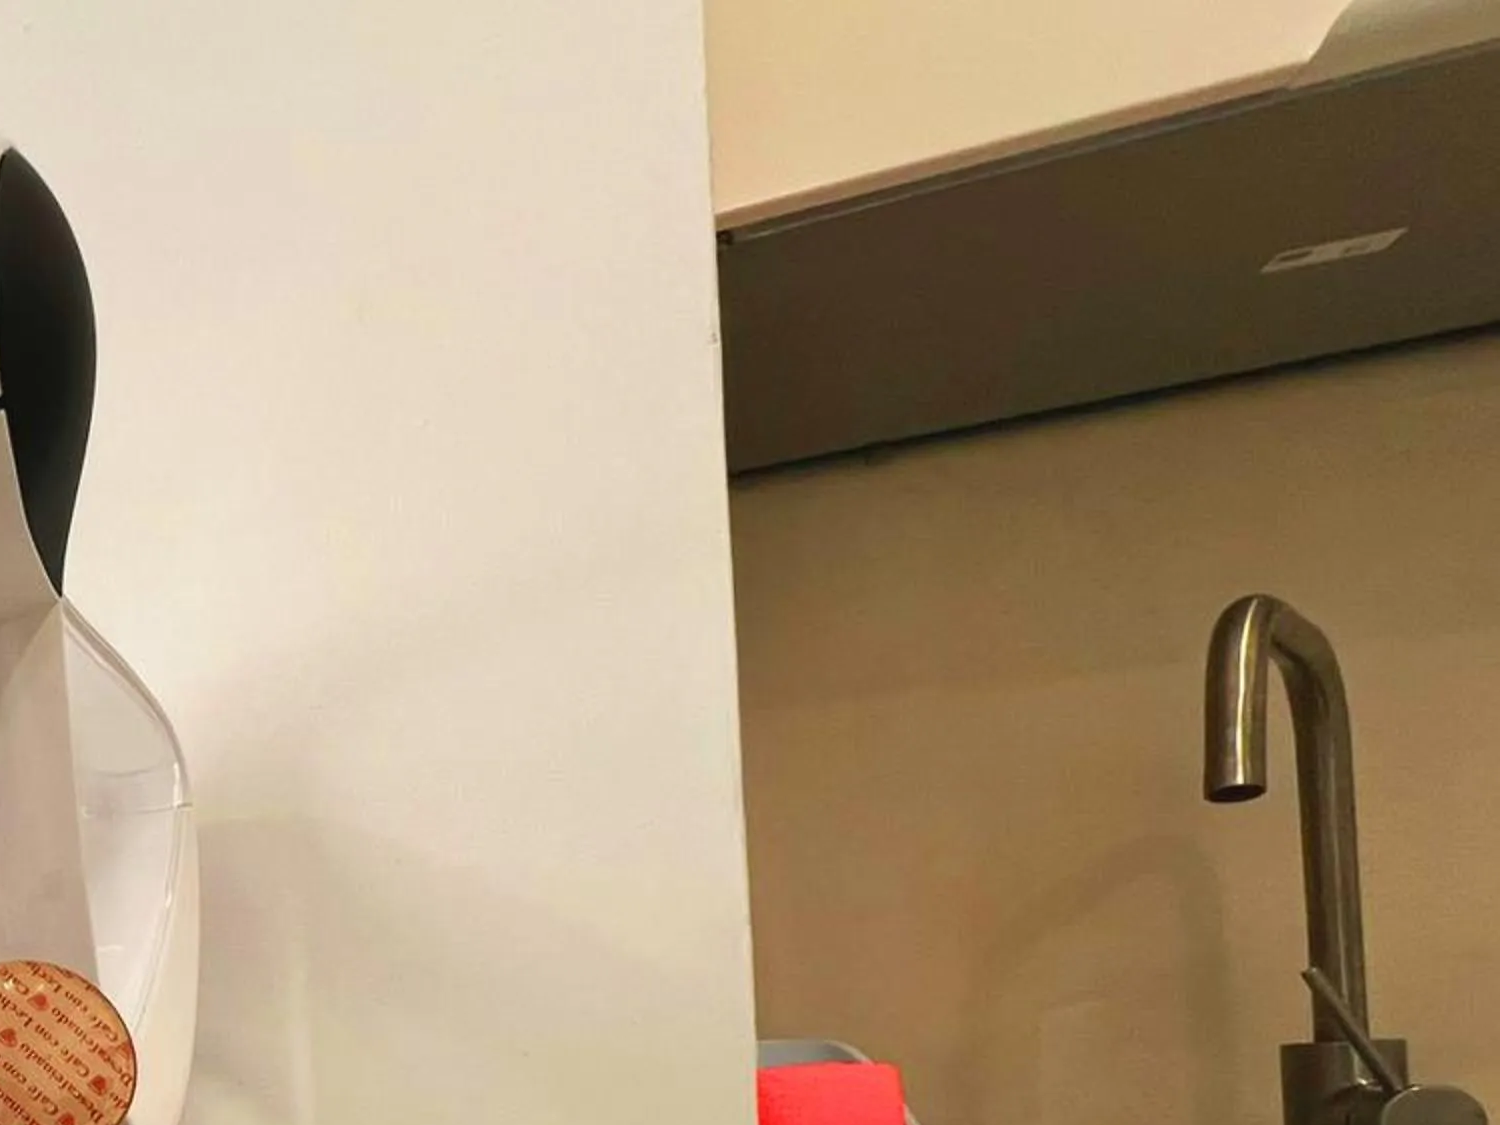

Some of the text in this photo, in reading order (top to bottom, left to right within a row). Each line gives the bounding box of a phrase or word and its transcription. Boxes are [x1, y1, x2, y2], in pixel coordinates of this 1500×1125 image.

[33, 1023, 60, 1048] con
[48, 1005, 134, 1087] Descafeinado
[0, 1059, 28, 1085] con
[16, 1040, 104, 1124] Descafeinado
